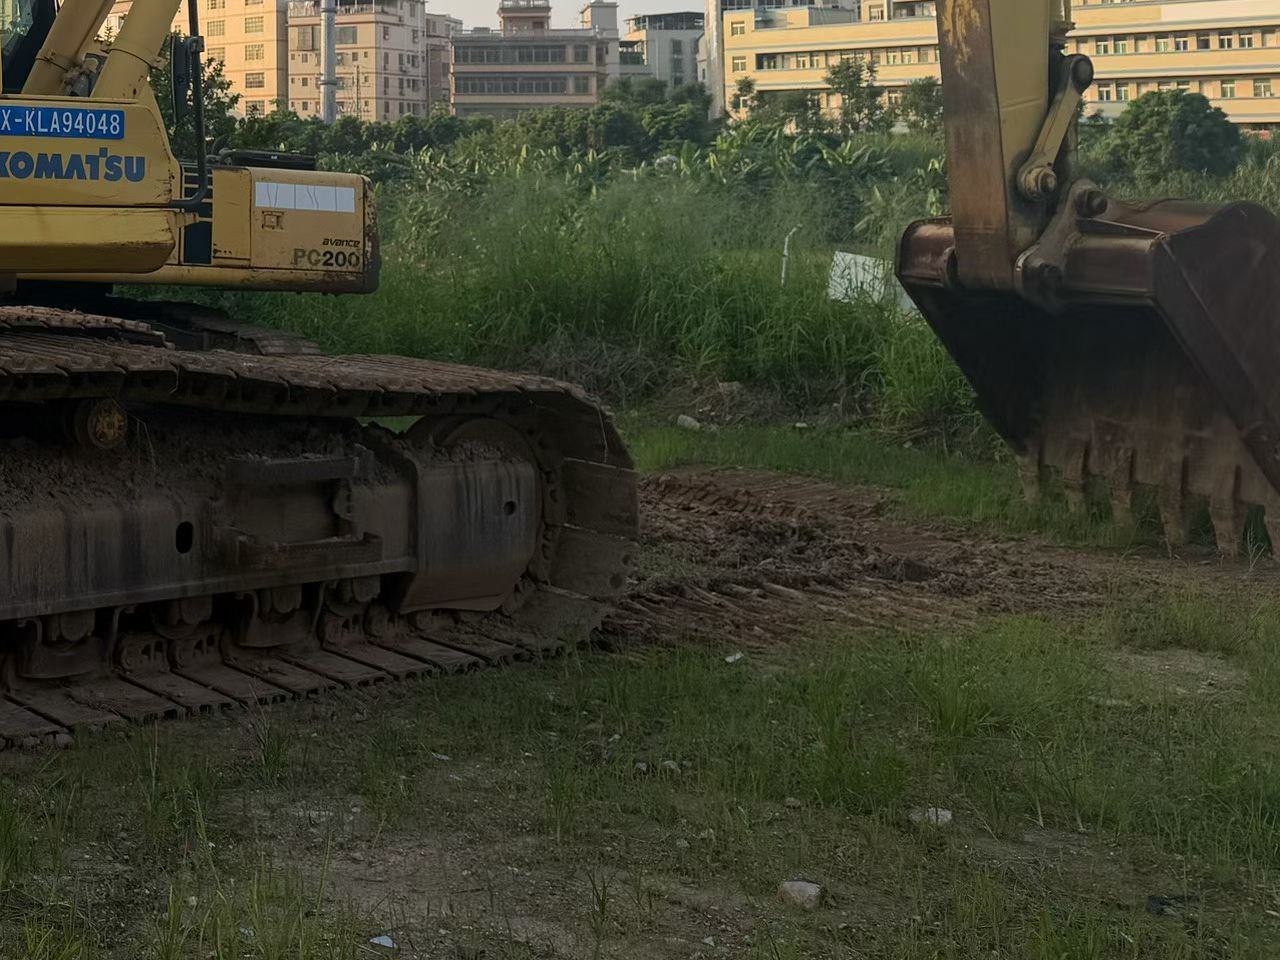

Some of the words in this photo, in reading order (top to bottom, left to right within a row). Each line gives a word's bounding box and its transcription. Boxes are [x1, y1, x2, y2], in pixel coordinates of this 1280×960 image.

[0, 109, 121, 135] X-KLA94048
[322, 237, 361, 248] avance
[293, 247, 360, 268] PC200
